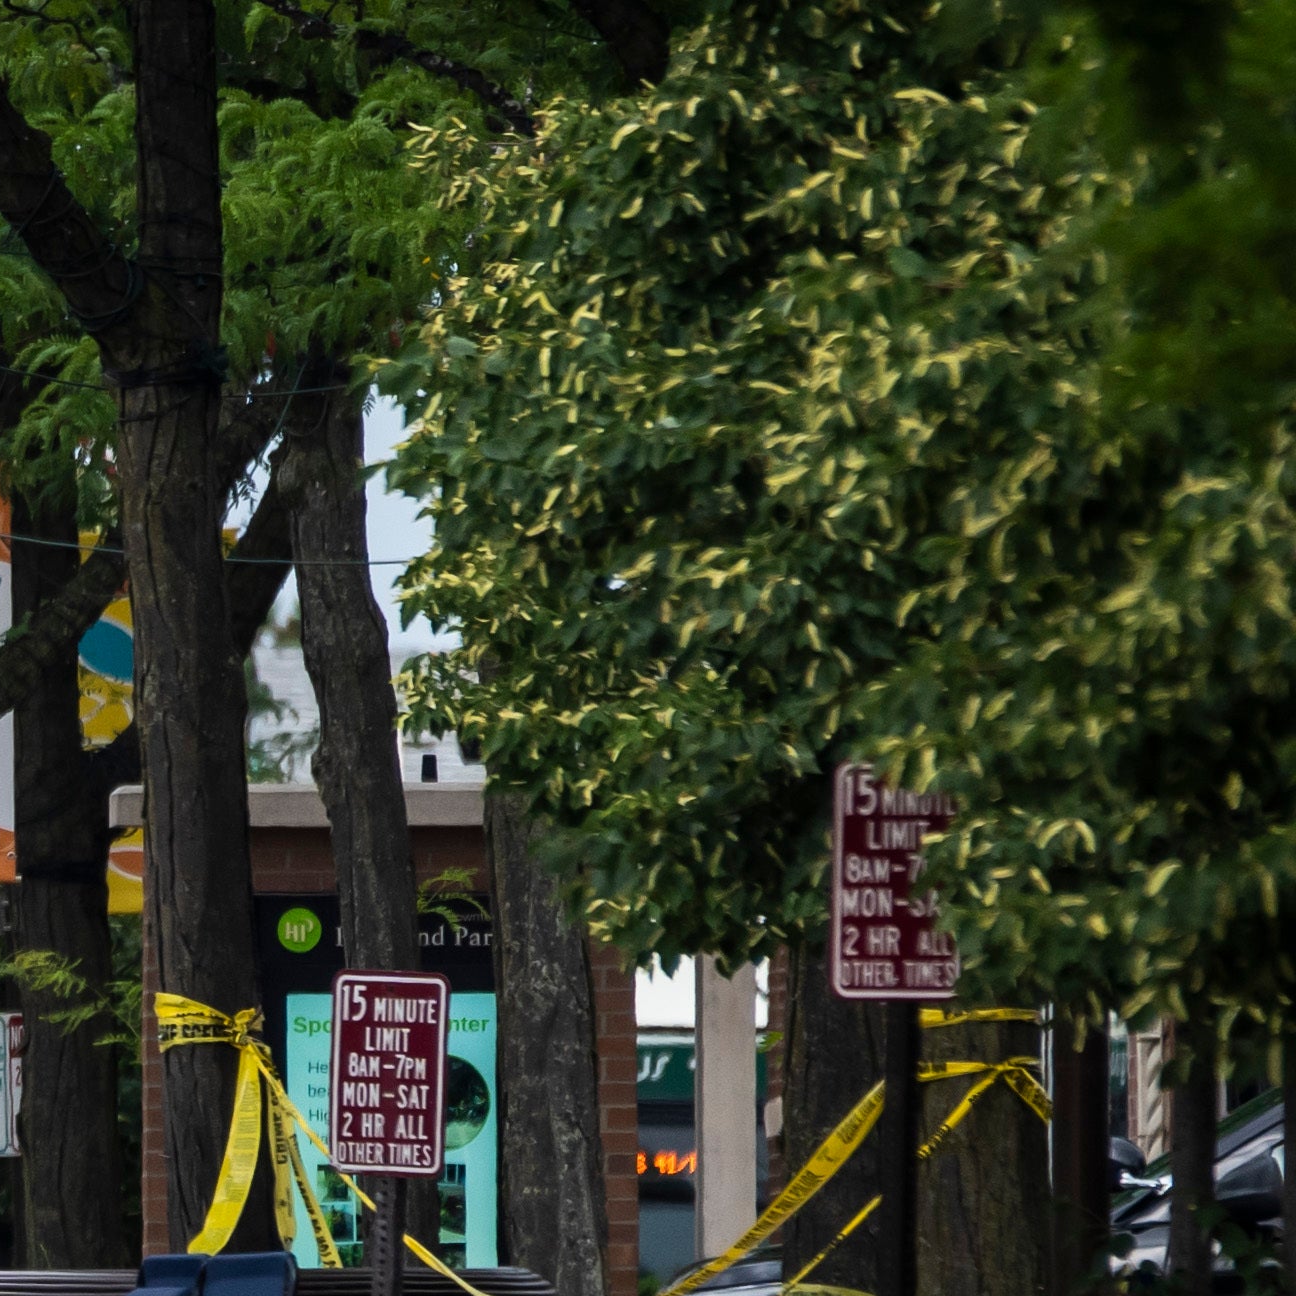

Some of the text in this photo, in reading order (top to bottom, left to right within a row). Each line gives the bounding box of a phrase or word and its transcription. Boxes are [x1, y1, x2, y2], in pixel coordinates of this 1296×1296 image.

[844, 774, 878, 815] 15
[843, 926, 859, 956] 2
[868, 926, 901, 956] HR
[342, 985, 437, 1024] 15 MINUTE
[365, 1027, 411, 1052] LIMIT
[342, 1112, 428, 1140] 2 HR ALL
[337, 1142, 432, 1166] OTHER TIMES
